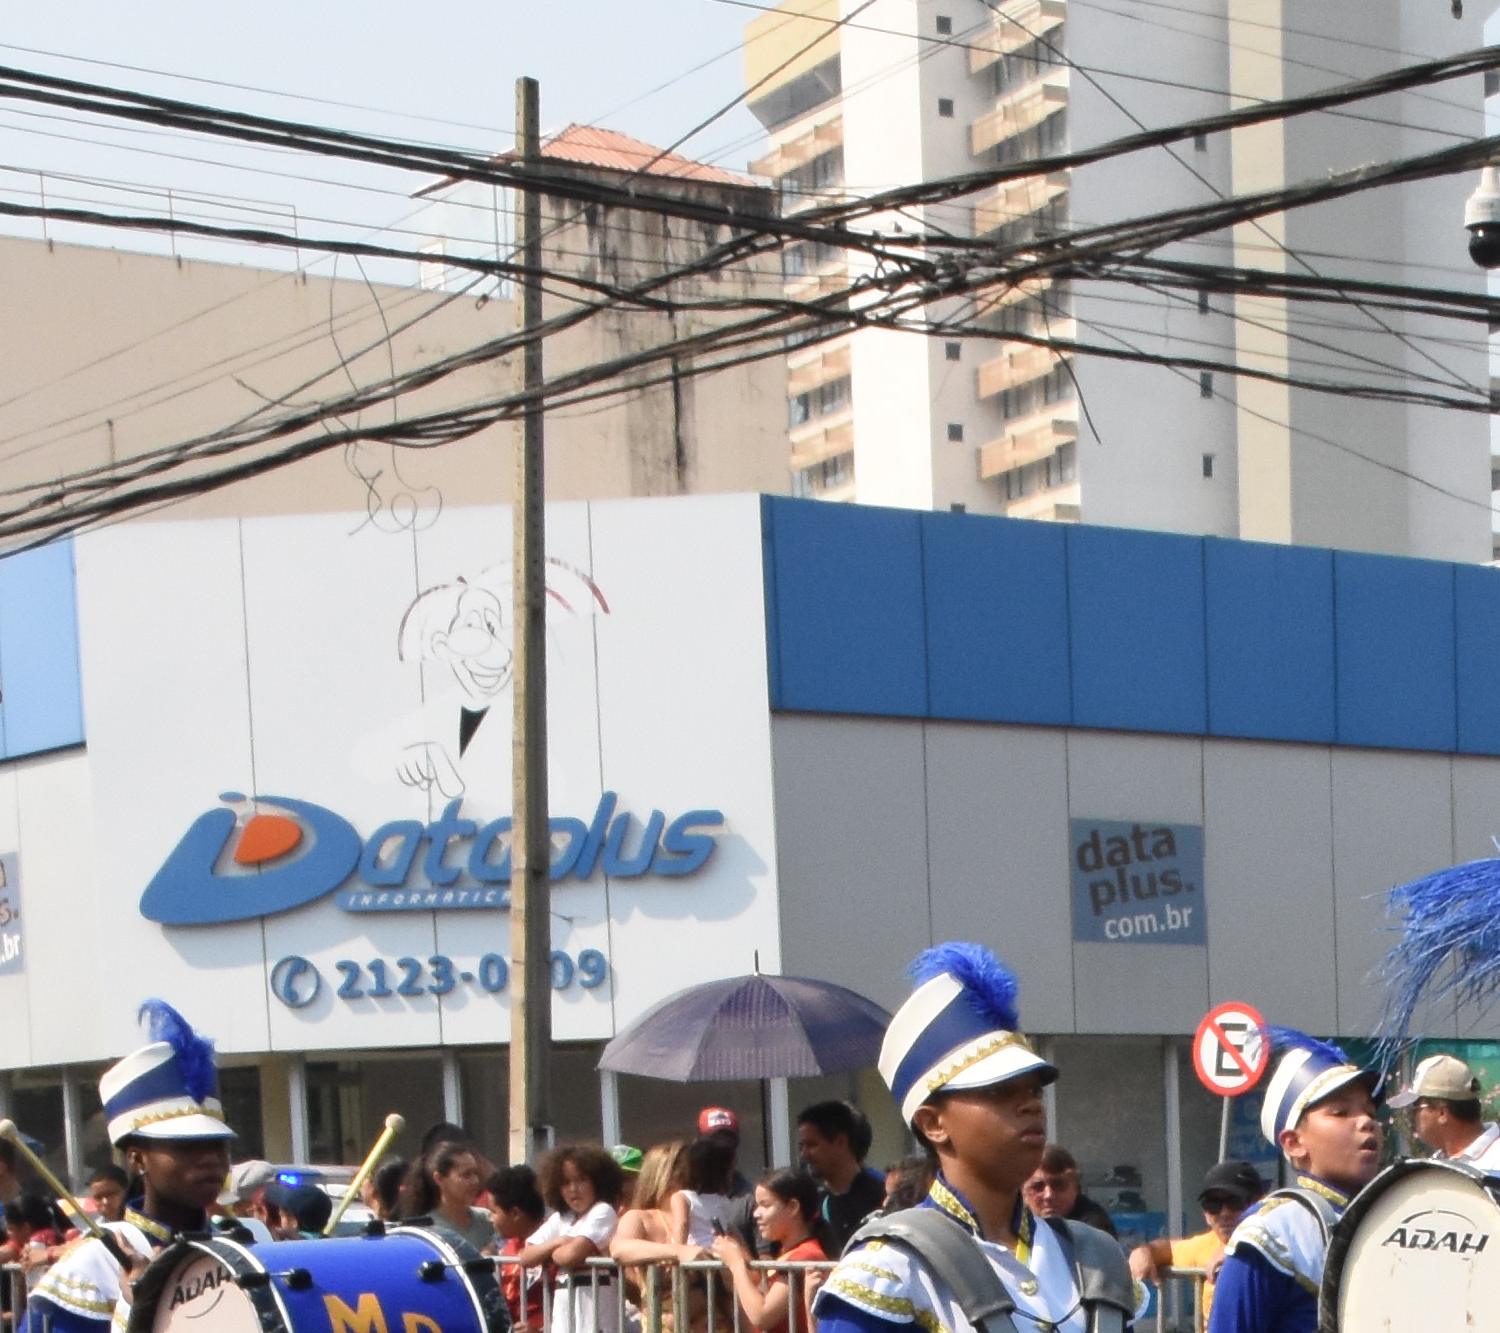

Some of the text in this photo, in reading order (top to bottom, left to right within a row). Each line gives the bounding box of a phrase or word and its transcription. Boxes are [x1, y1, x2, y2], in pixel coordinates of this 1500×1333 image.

[1076, 824, 1177, 873] data
[1089, 866, 1195, 917] plus.
[1105, 904, 1192, 939] com.br
[336, 948, 606, 999] 2123-009
[1381, 1227, 1491, 1254] ADAH
